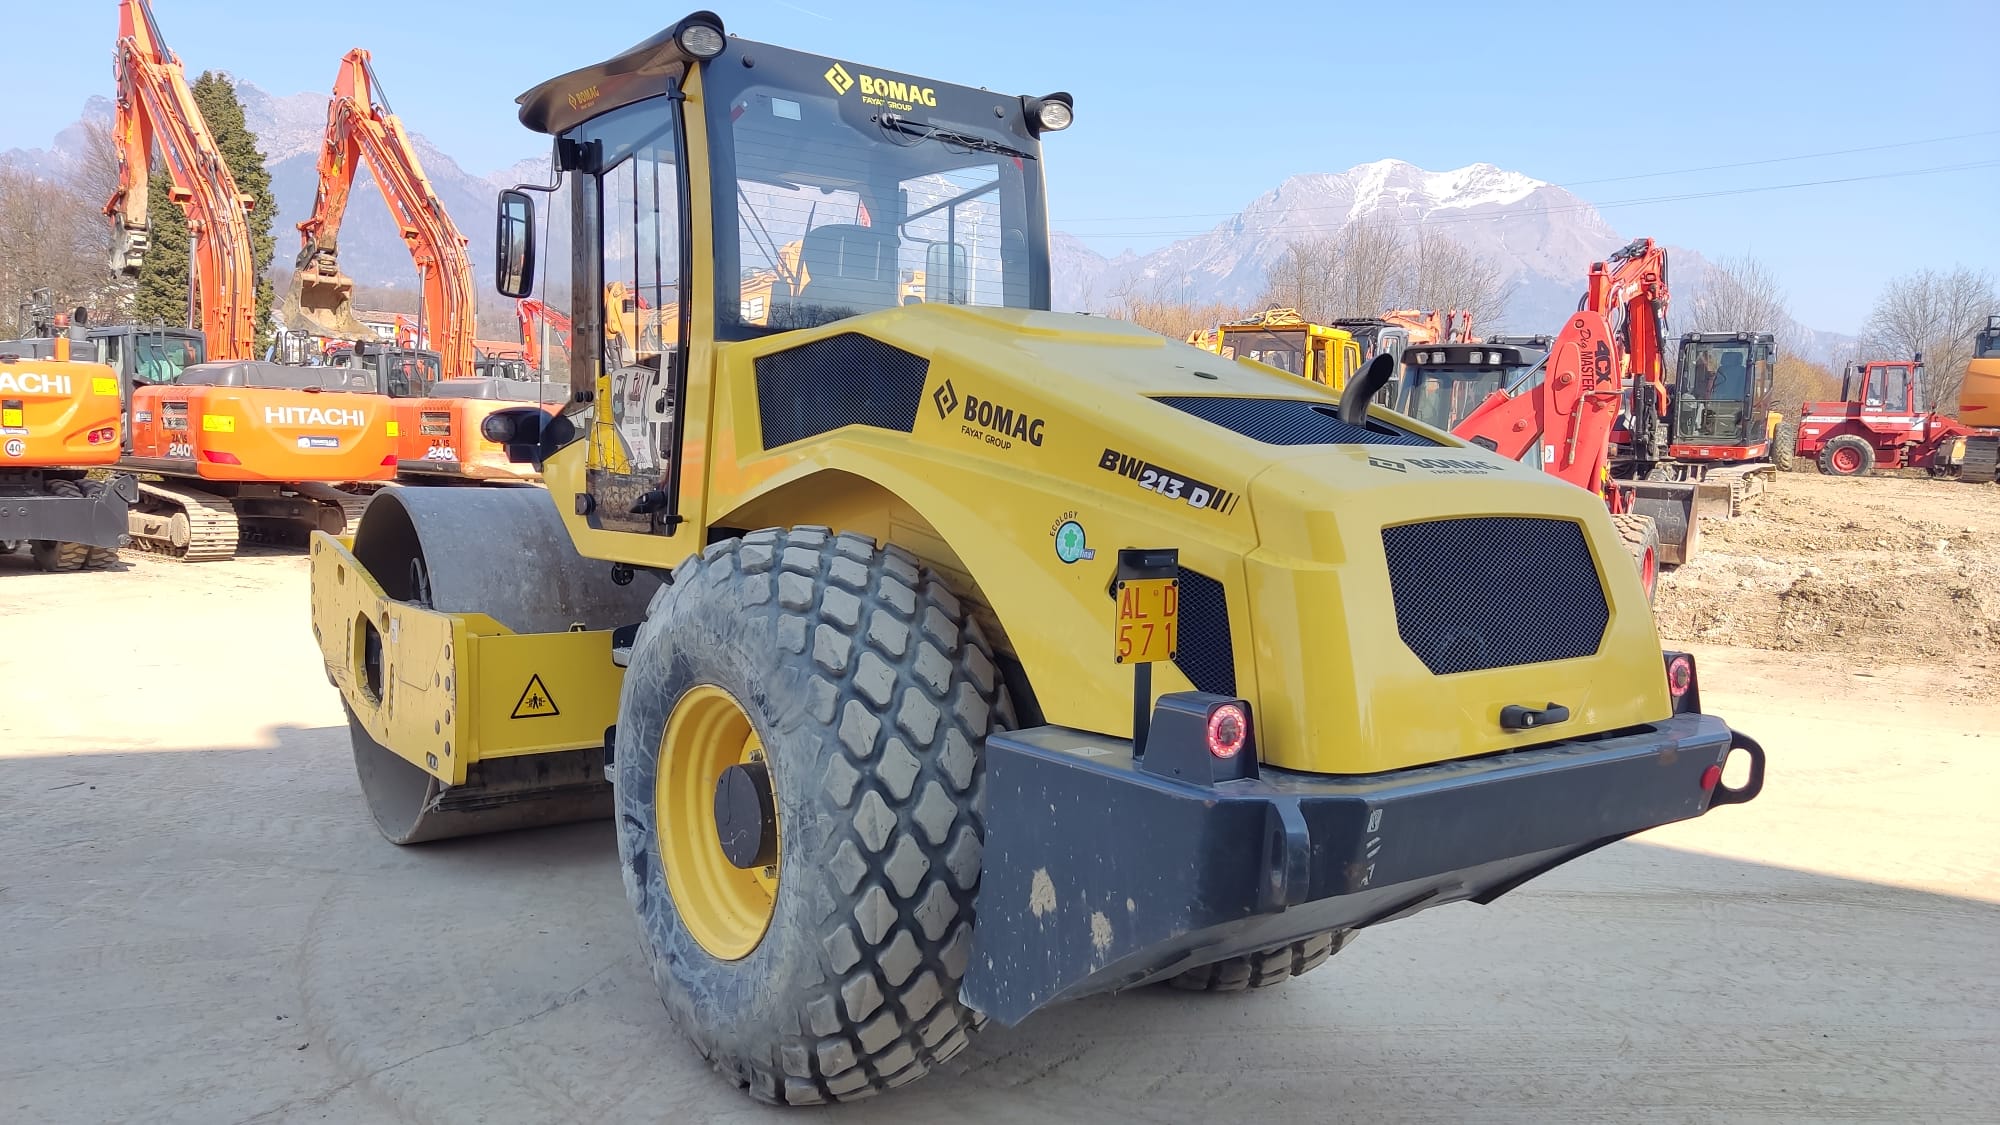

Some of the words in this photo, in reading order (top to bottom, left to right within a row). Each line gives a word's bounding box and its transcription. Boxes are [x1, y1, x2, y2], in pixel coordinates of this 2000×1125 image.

[859, 74, 937, 107] BOMAG
[1577, 328, 1592, 350] Dig
[1581, 350, 1595, 391] MASTER
[1594, 340, 1612, 384] 4CX
[0, 371, 72, 395] ACHI
[264, 406, 365, 427] HITACHI
[964, 394, 1045, 447] BOMAG
[9, 443, 21, 453] 40
[961, 425, 984, 440] FAYAT
[985, 434, 1012, 450] GROUP
[1049, 510, 1078, 537] ECOLOGY
[1120, 587, 1148, 620] AL
[1163, 585, 1177, 617] D
[1119, 622, 1171, 657] 571
